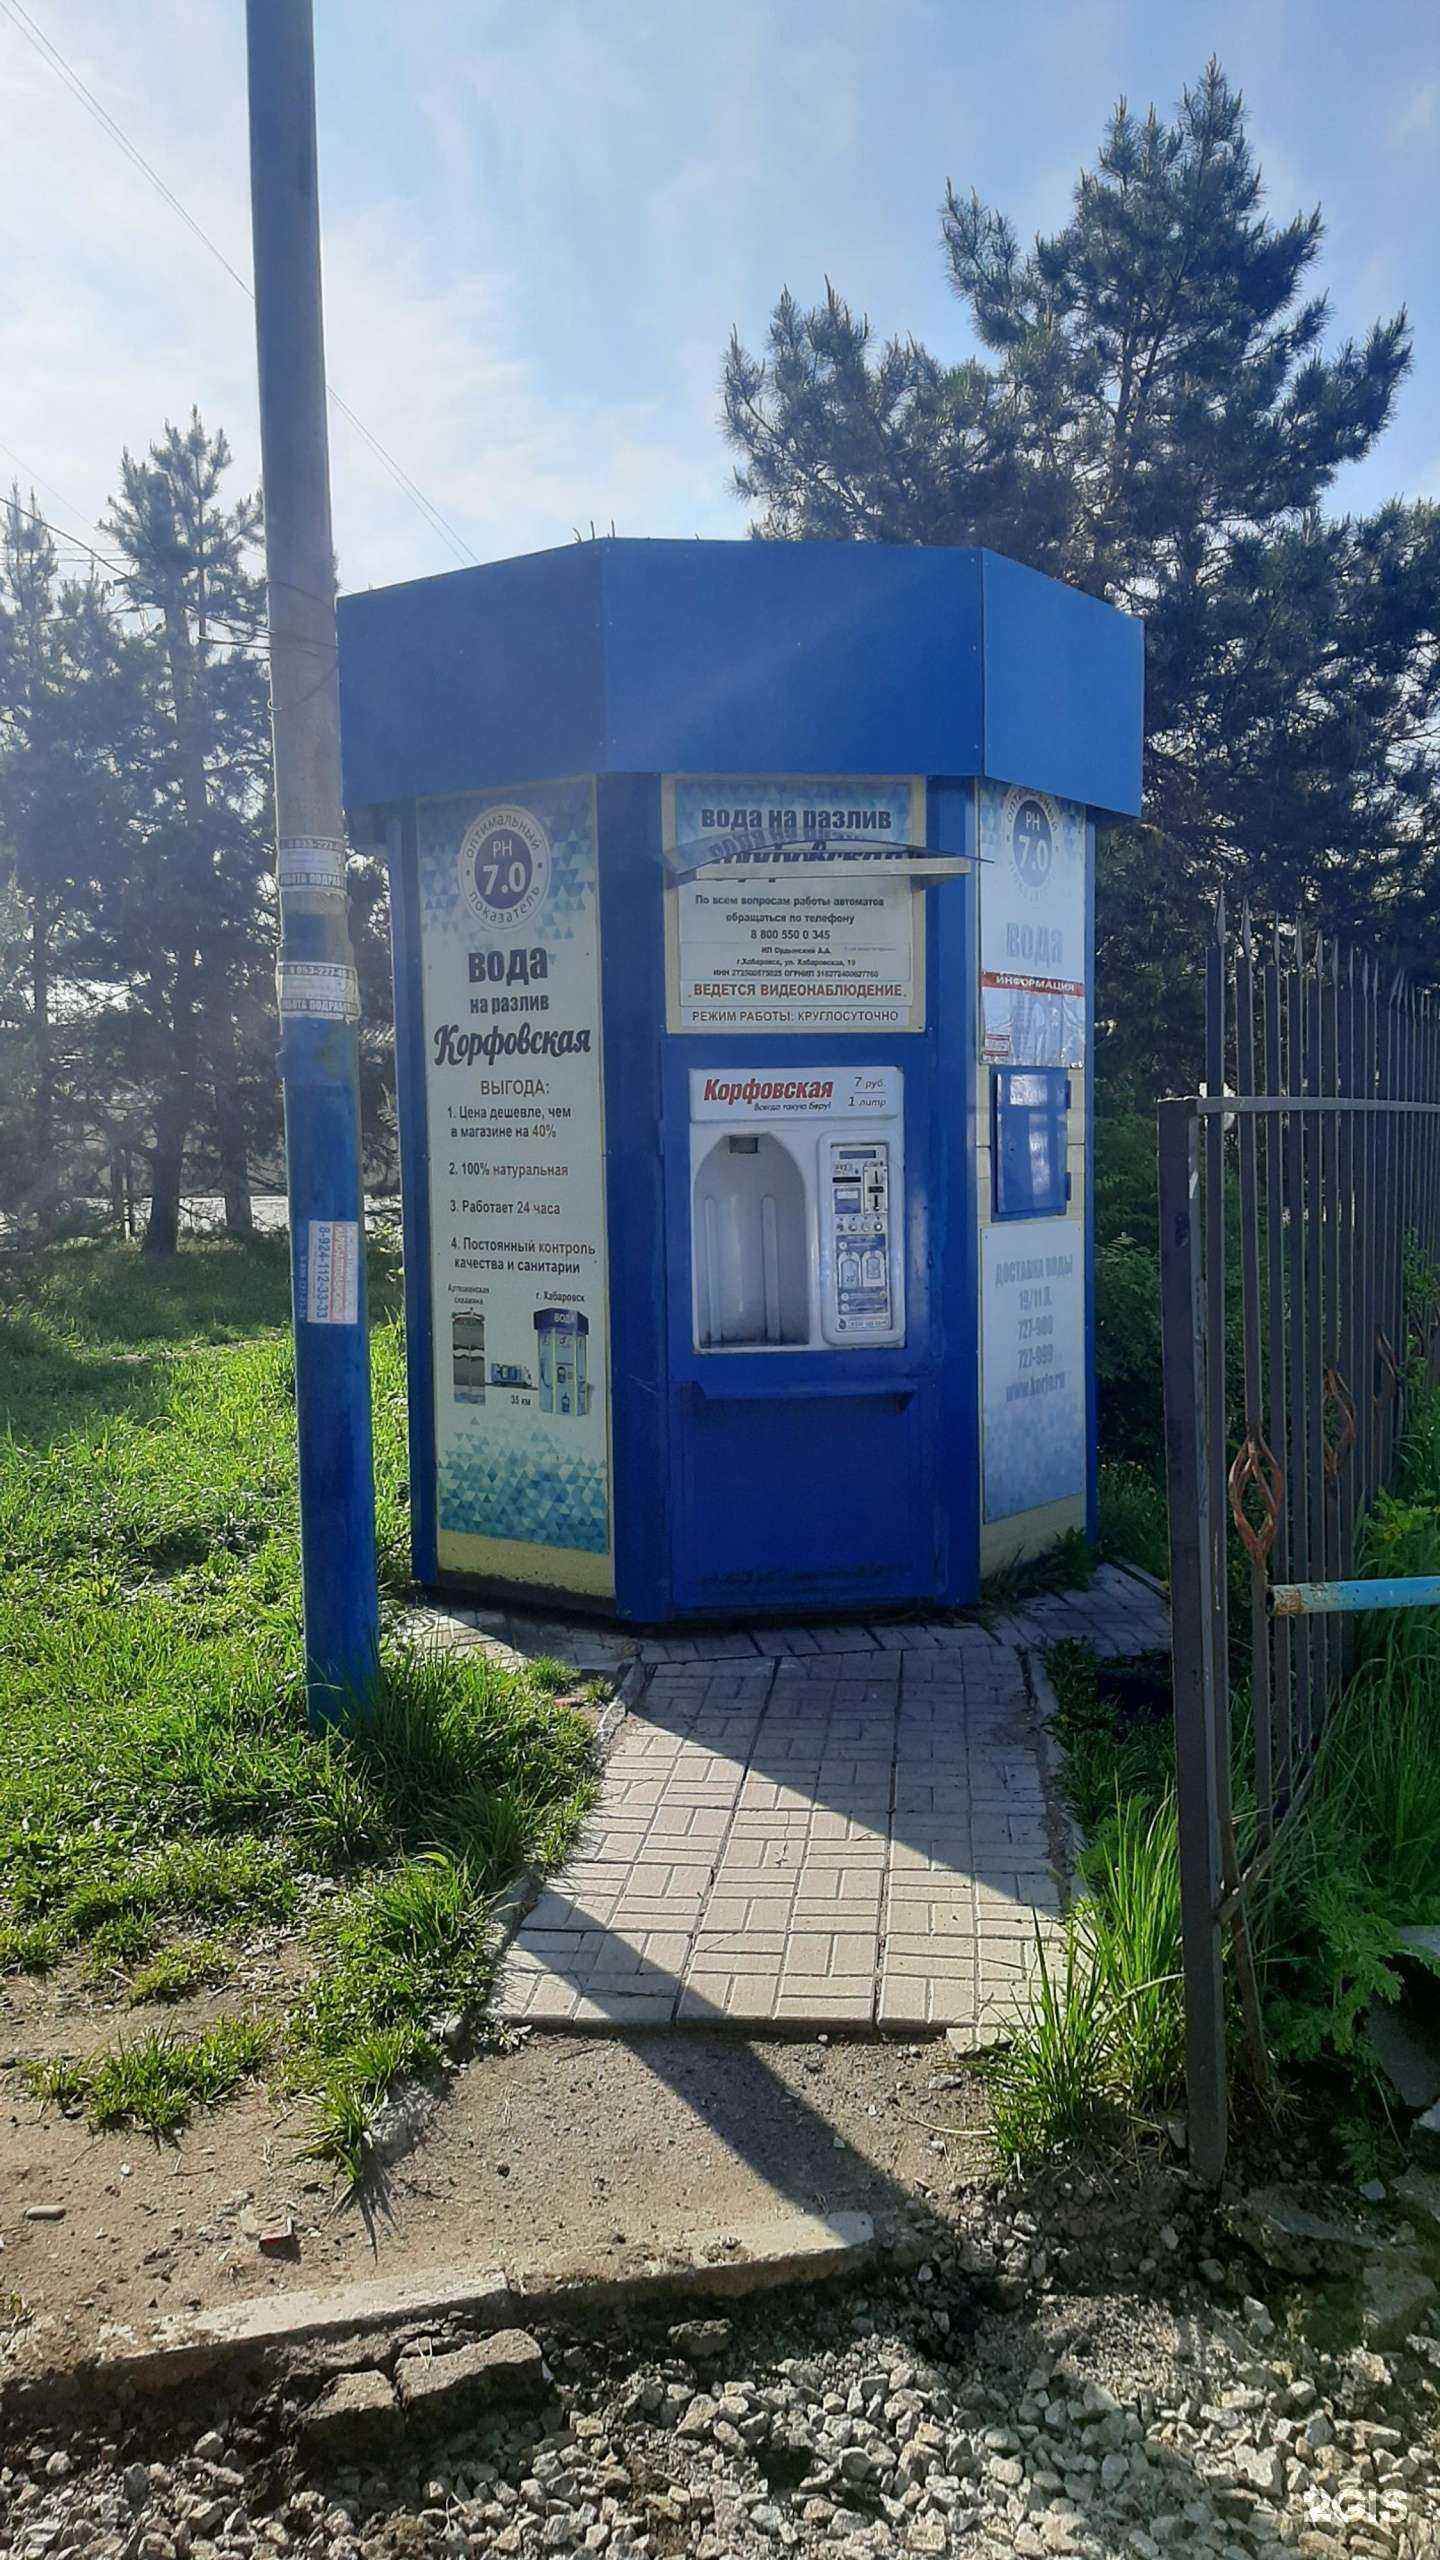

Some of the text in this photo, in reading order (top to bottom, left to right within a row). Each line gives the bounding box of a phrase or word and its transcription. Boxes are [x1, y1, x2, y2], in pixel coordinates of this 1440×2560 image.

[702, 808, 892, 830] вода на разлив
[1018, 834, 1048, 871] 7.0
[482, 861, 526, 895] 7.0
[695, 895, 884, 907] По всем вопросам работы автоматов
[725, 912, 855, 925] обращаться по телефону
[750, 930, 831, 939] 8 800 550 0 345
[1006, 923, 1063, 967] вода
[469, 946, 548, 986] вода
[693, 983, 902, 998] ВЕДЕТСЯ ВИДЕОНАБЛЮДЕНИЕ
[995, 975, 1076, 992] ИНФОРМАЦИЯ
[470, 993, 550, 1015] на разлив
[692, 1010, 737, 1022] РЕЖИМ
[798, 1010, 899, 1022] КРУГЛОСУТОЧНО
[433, 1022, 591, 1066] Корфовская
[481, 1080, 550, 1097] ВЫГОДА:
[854, 1076, 862, 1087] 7
[704, 1078, 834, 1105] Корфовская
[753, 1101, 832, 1112] Всегда такую беру!
[848, 1097, 887, 1107] 1 литр
[447, 1106, 571, 1121] 1. Цена дешевле, чем
[461, 1126, 512, 1137] магазине
[515, 1126, 529, 1137] на
[532, 1124, 557, 1139] 40%
[448, 1162, 569, 1179] 2. 100% натуральная
[449, 1200, 561, 1214] 3. Работает 24 часа
[450, 1237, 596, 1256] 4. Постоянный контроль
[454, 1257, 581, 1276] качества и санитарии
[543, 1289, 586, 1303] Хабаровск
